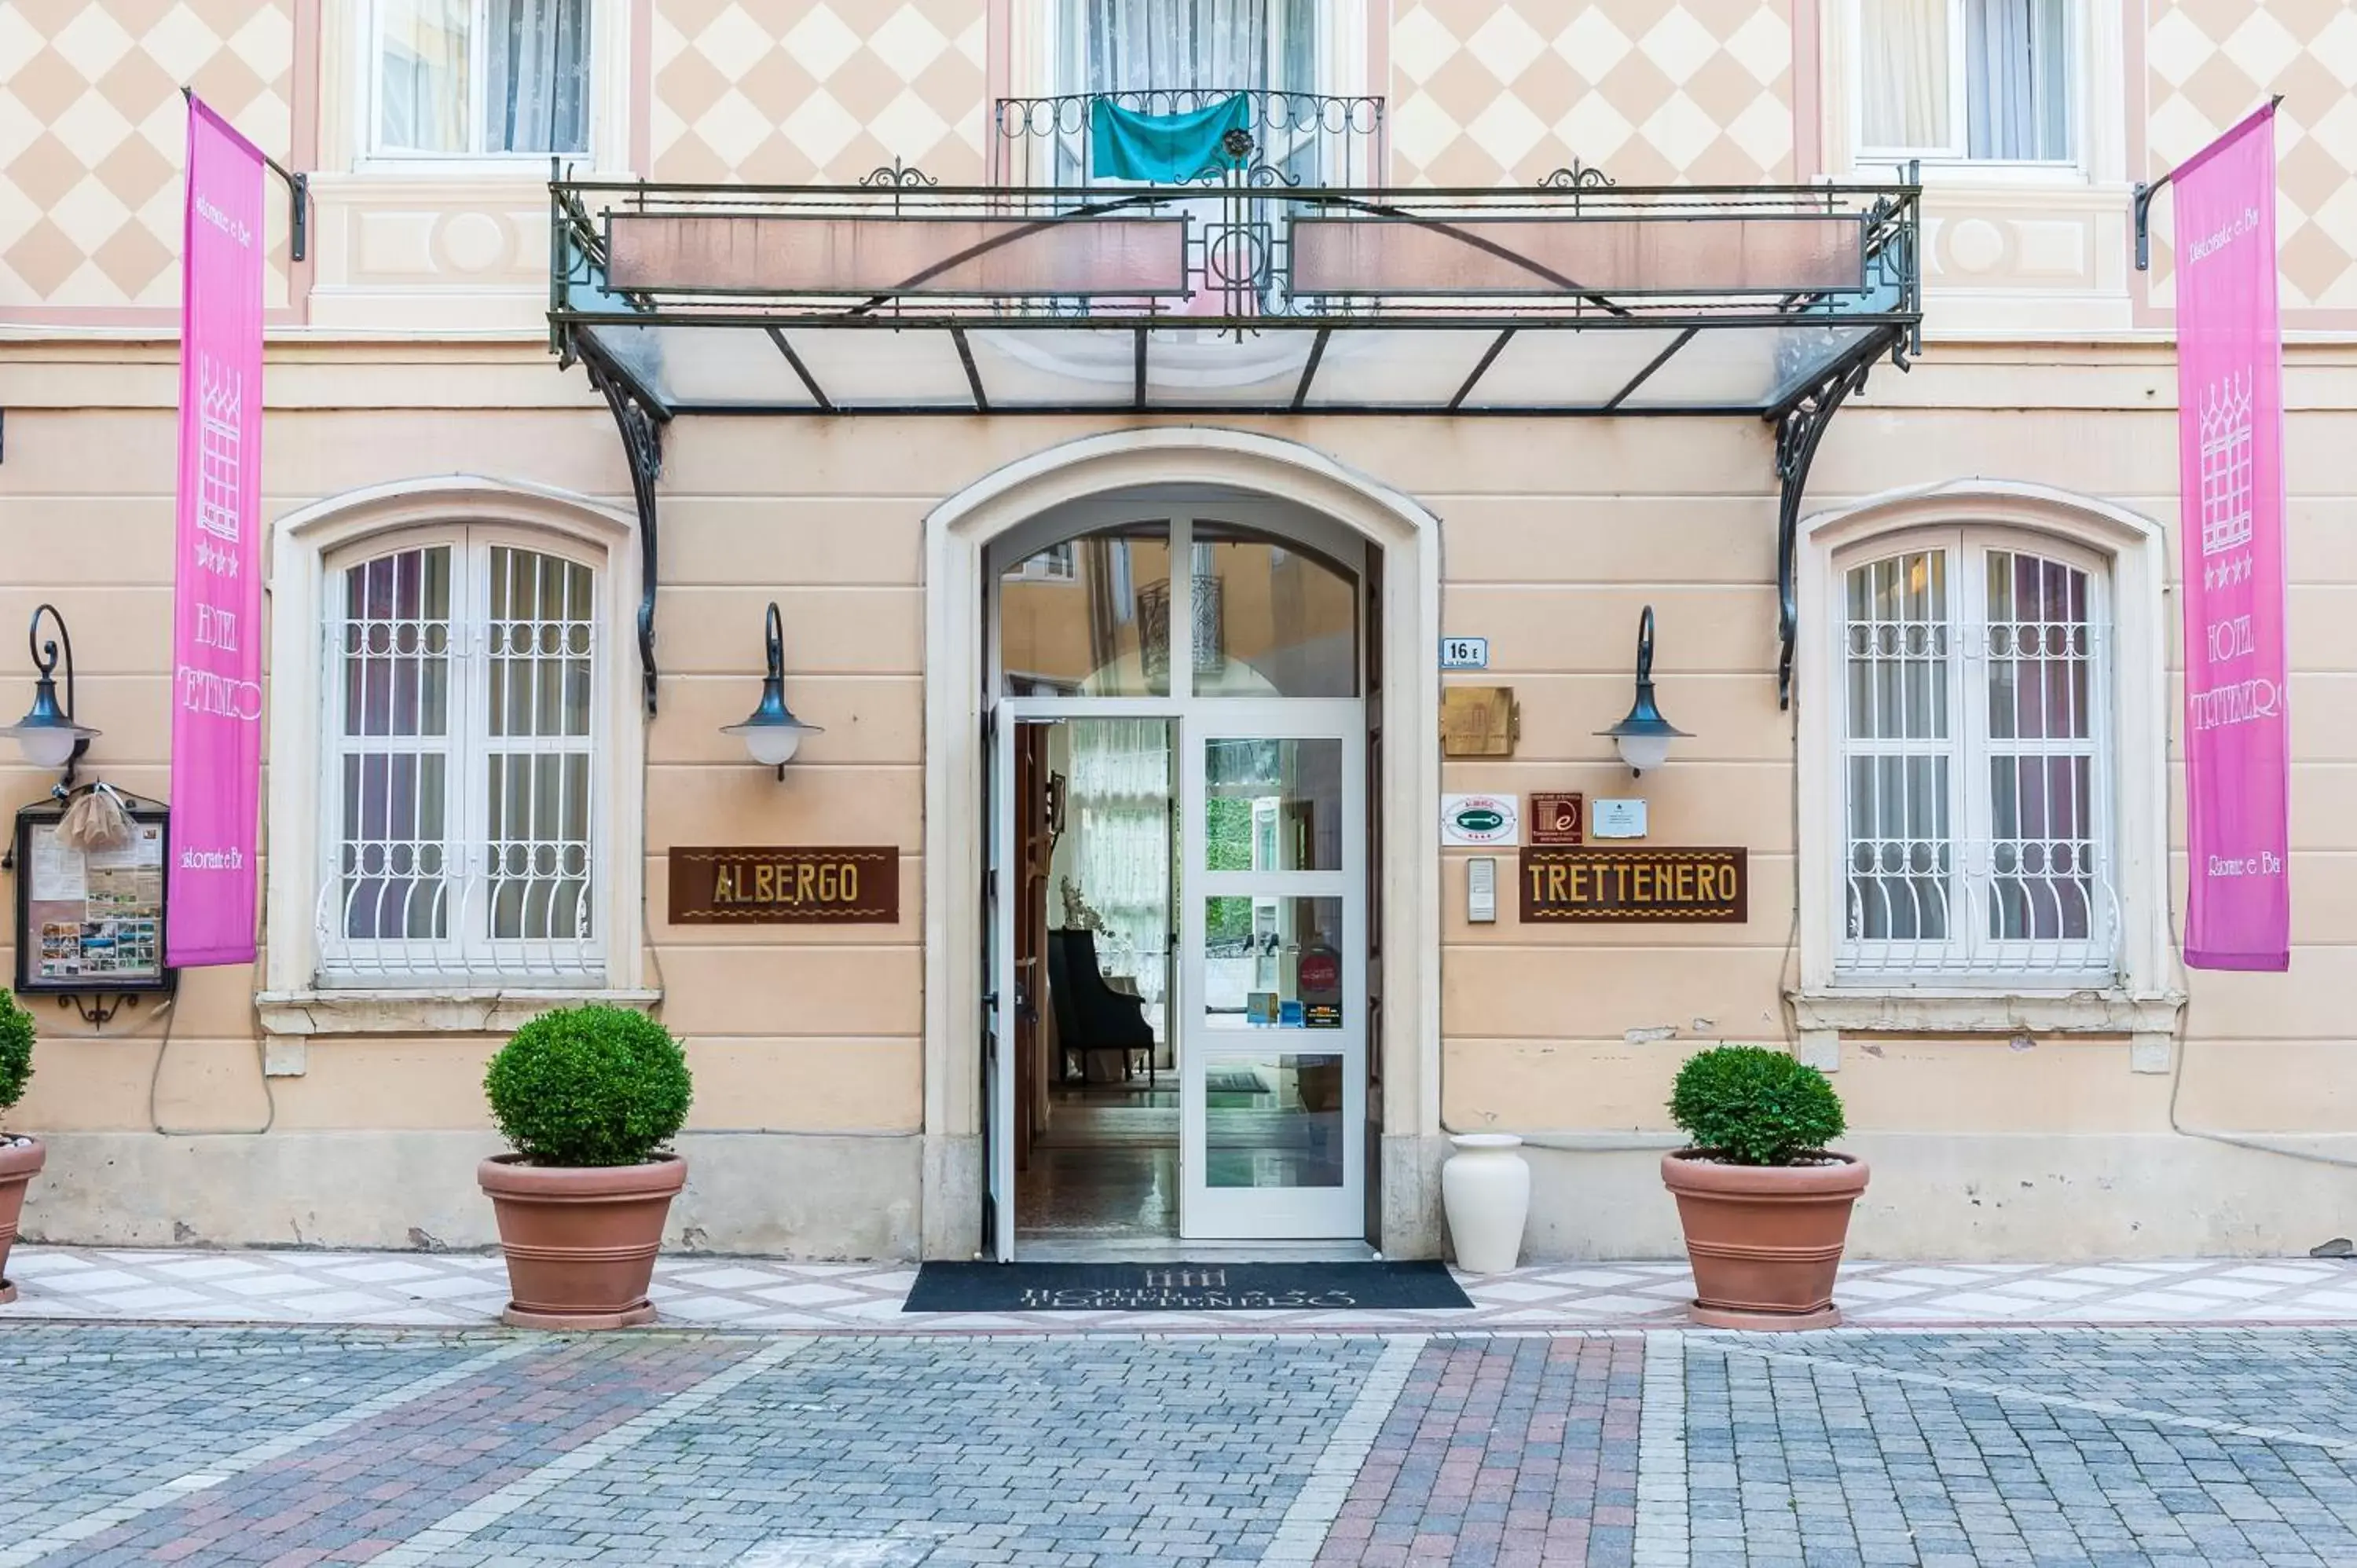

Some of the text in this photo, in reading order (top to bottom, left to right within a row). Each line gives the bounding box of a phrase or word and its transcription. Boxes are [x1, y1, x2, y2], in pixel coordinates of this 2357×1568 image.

[1451, 643, 1478, 658] 16 E
[2208, 614, 2254, 663] HOTEL
[713, 863, 857, 903] ALBERGO
[1528, 863, 1736, 902] TRETTENERO
